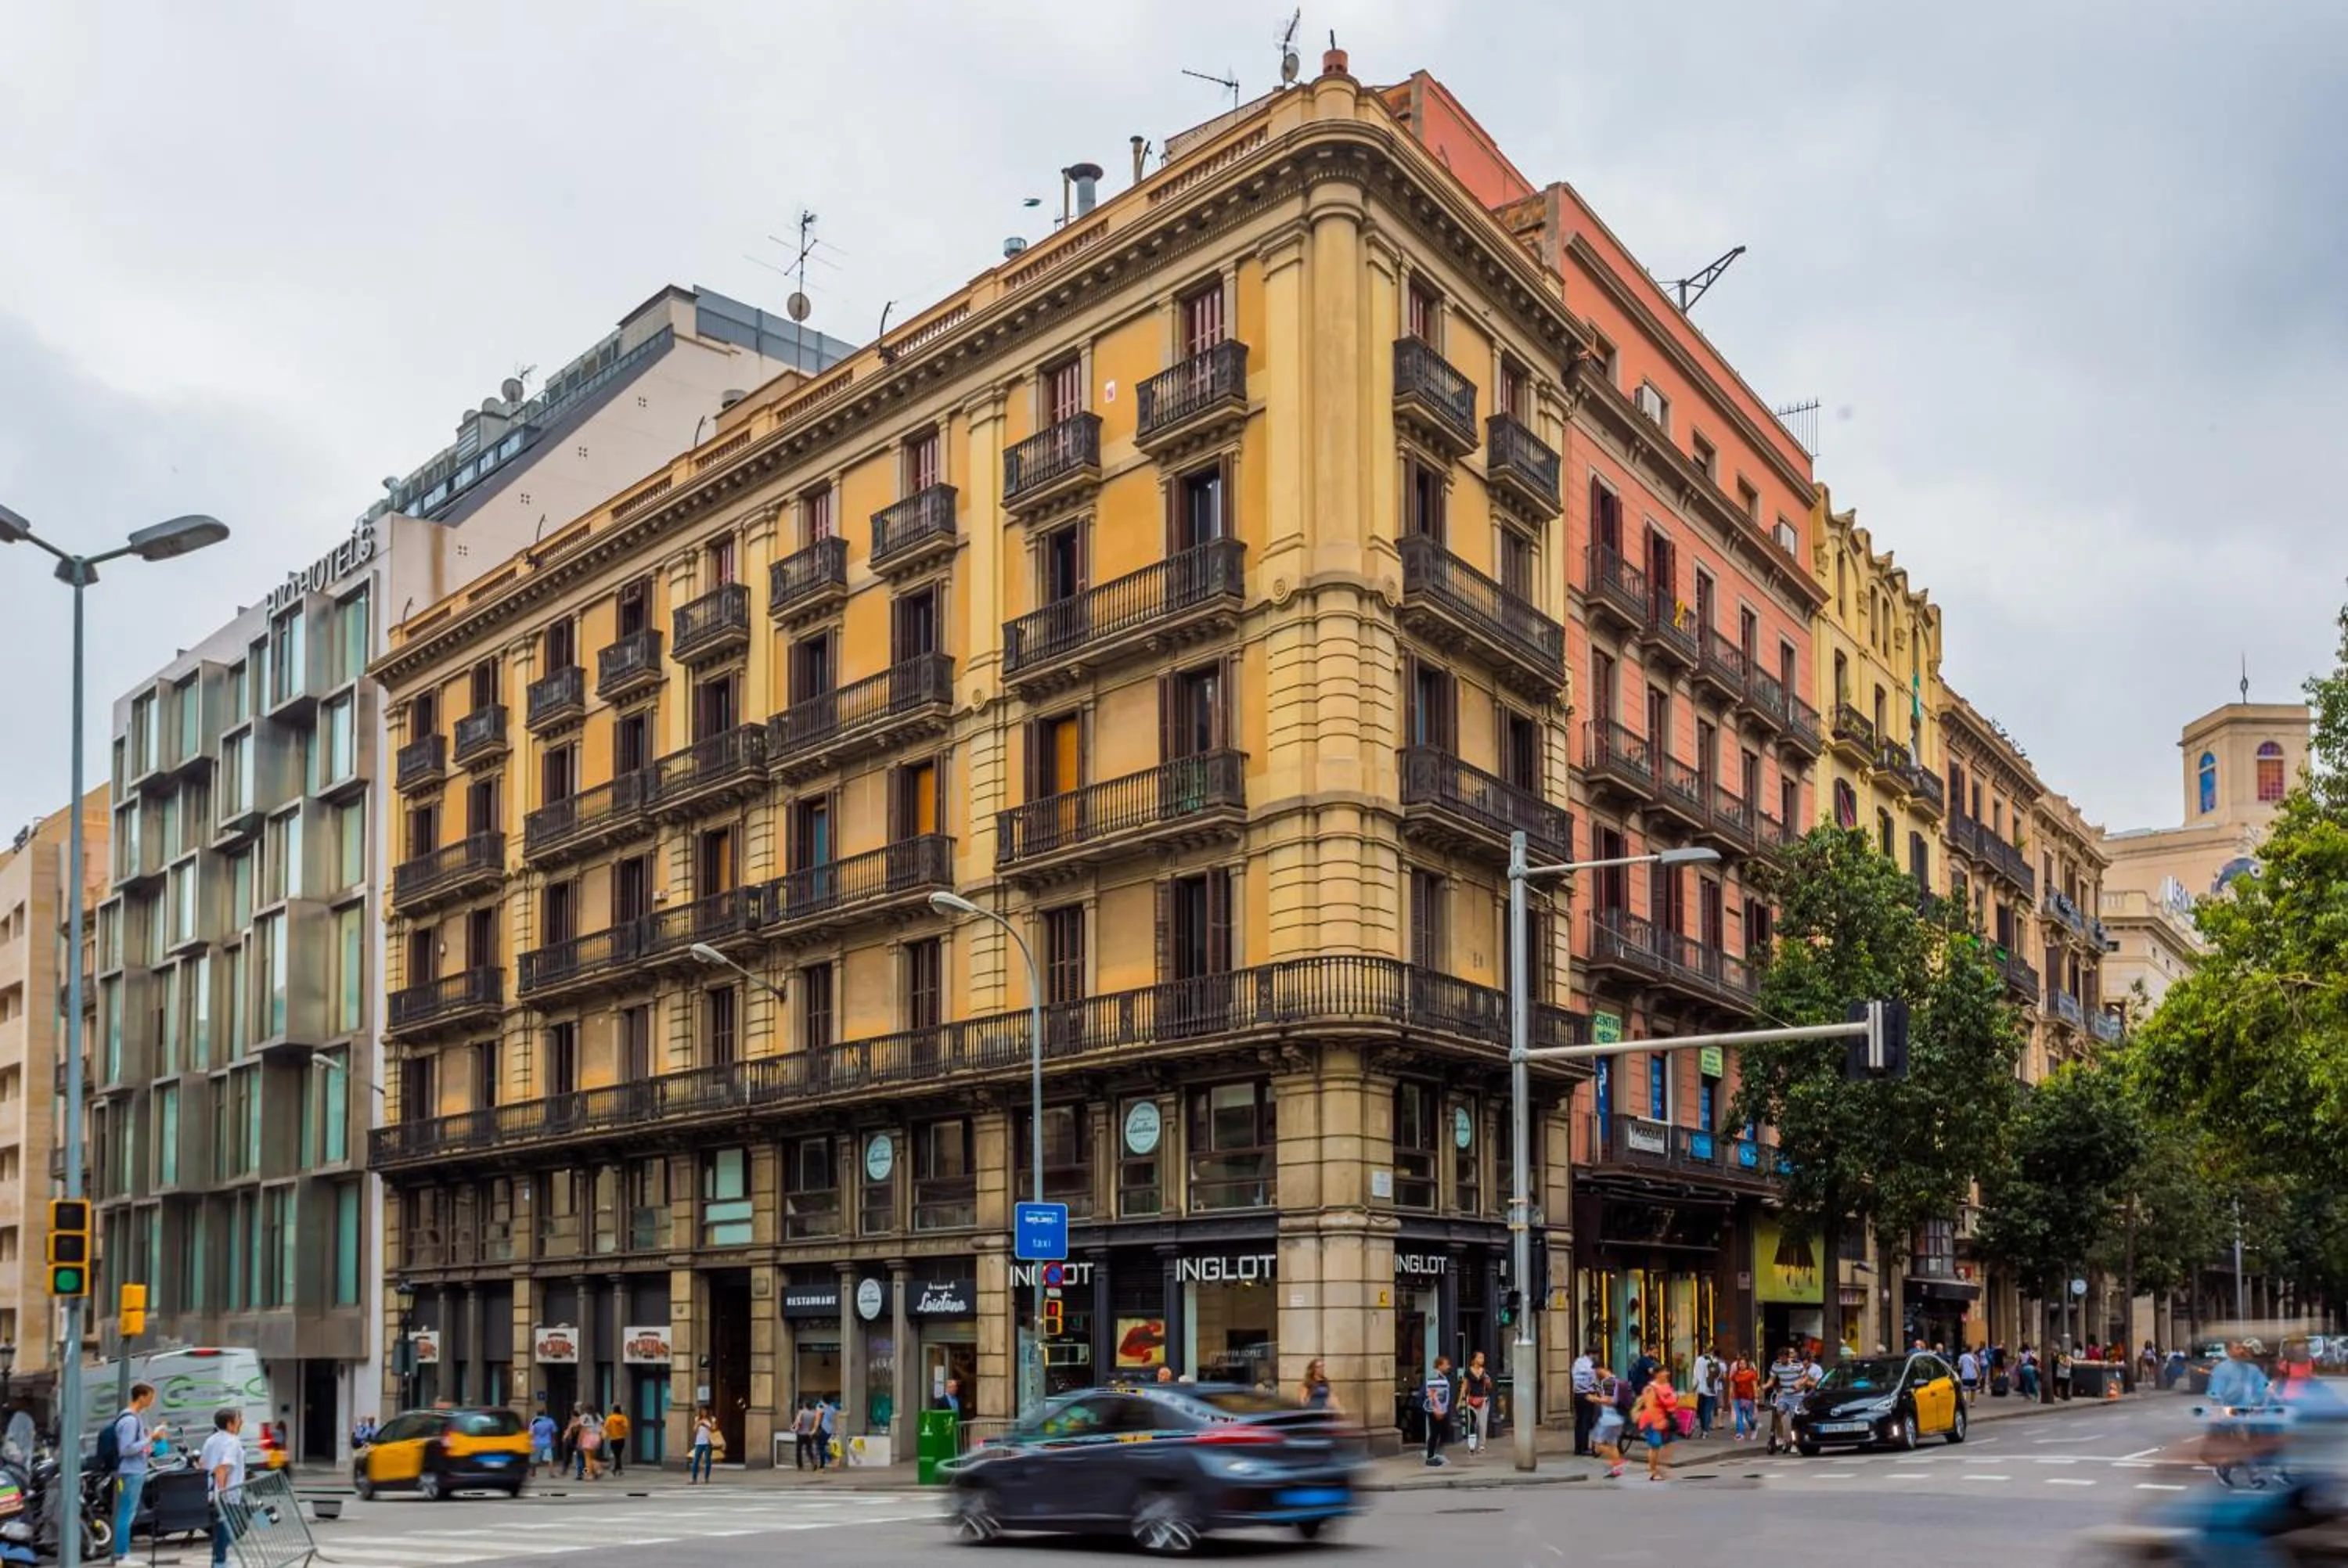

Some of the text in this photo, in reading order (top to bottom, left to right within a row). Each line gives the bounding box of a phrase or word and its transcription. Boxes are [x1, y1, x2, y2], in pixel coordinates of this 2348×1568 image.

[300, 525, 376, 593] HOTELS
[1032, 1238, 1051, 1248] taxi
[1009, 1262, 1094, 1286] INOT
[1176, 1254, 1277, 1282] INGLOT
[1394, 1253, 1446, 1275] INGLOT
[787, 1295, 836, 1306] RESTAURANT
